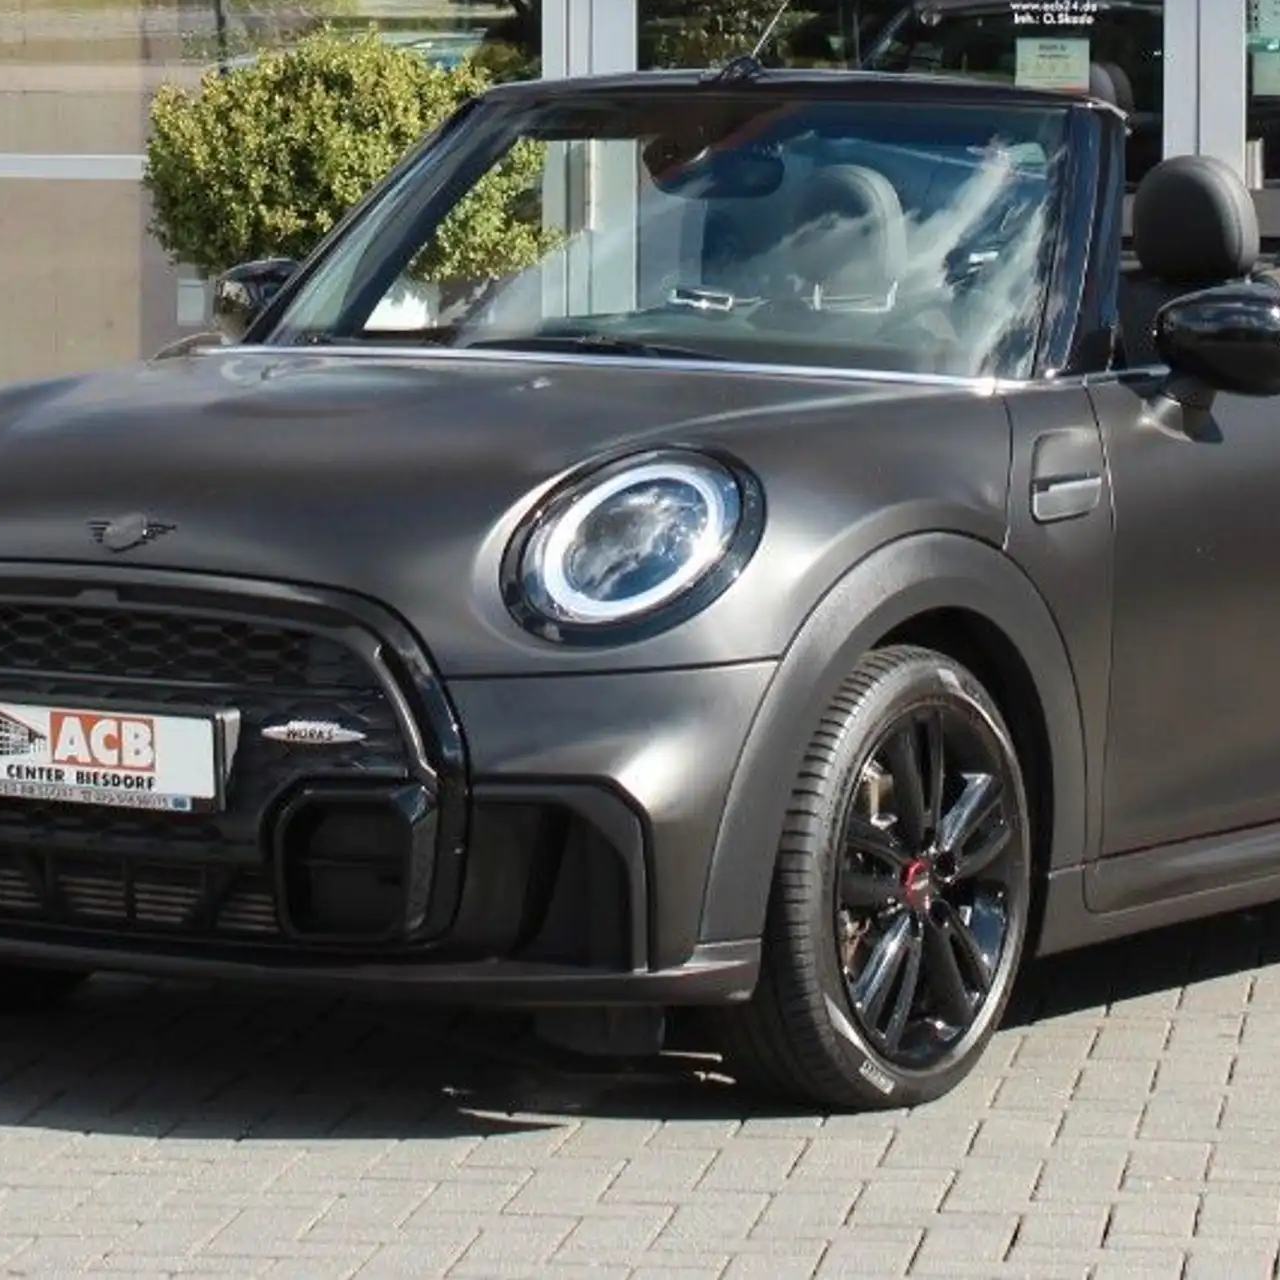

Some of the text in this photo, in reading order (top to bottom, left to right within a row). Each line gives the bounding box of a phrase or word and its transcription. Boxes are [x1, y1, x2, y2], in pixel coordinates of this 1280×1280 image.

[53, 716, 154, 767] ACB
[7, 764, 66, 783] CENTER
[76, 770, 155, 790] BIESDORF
